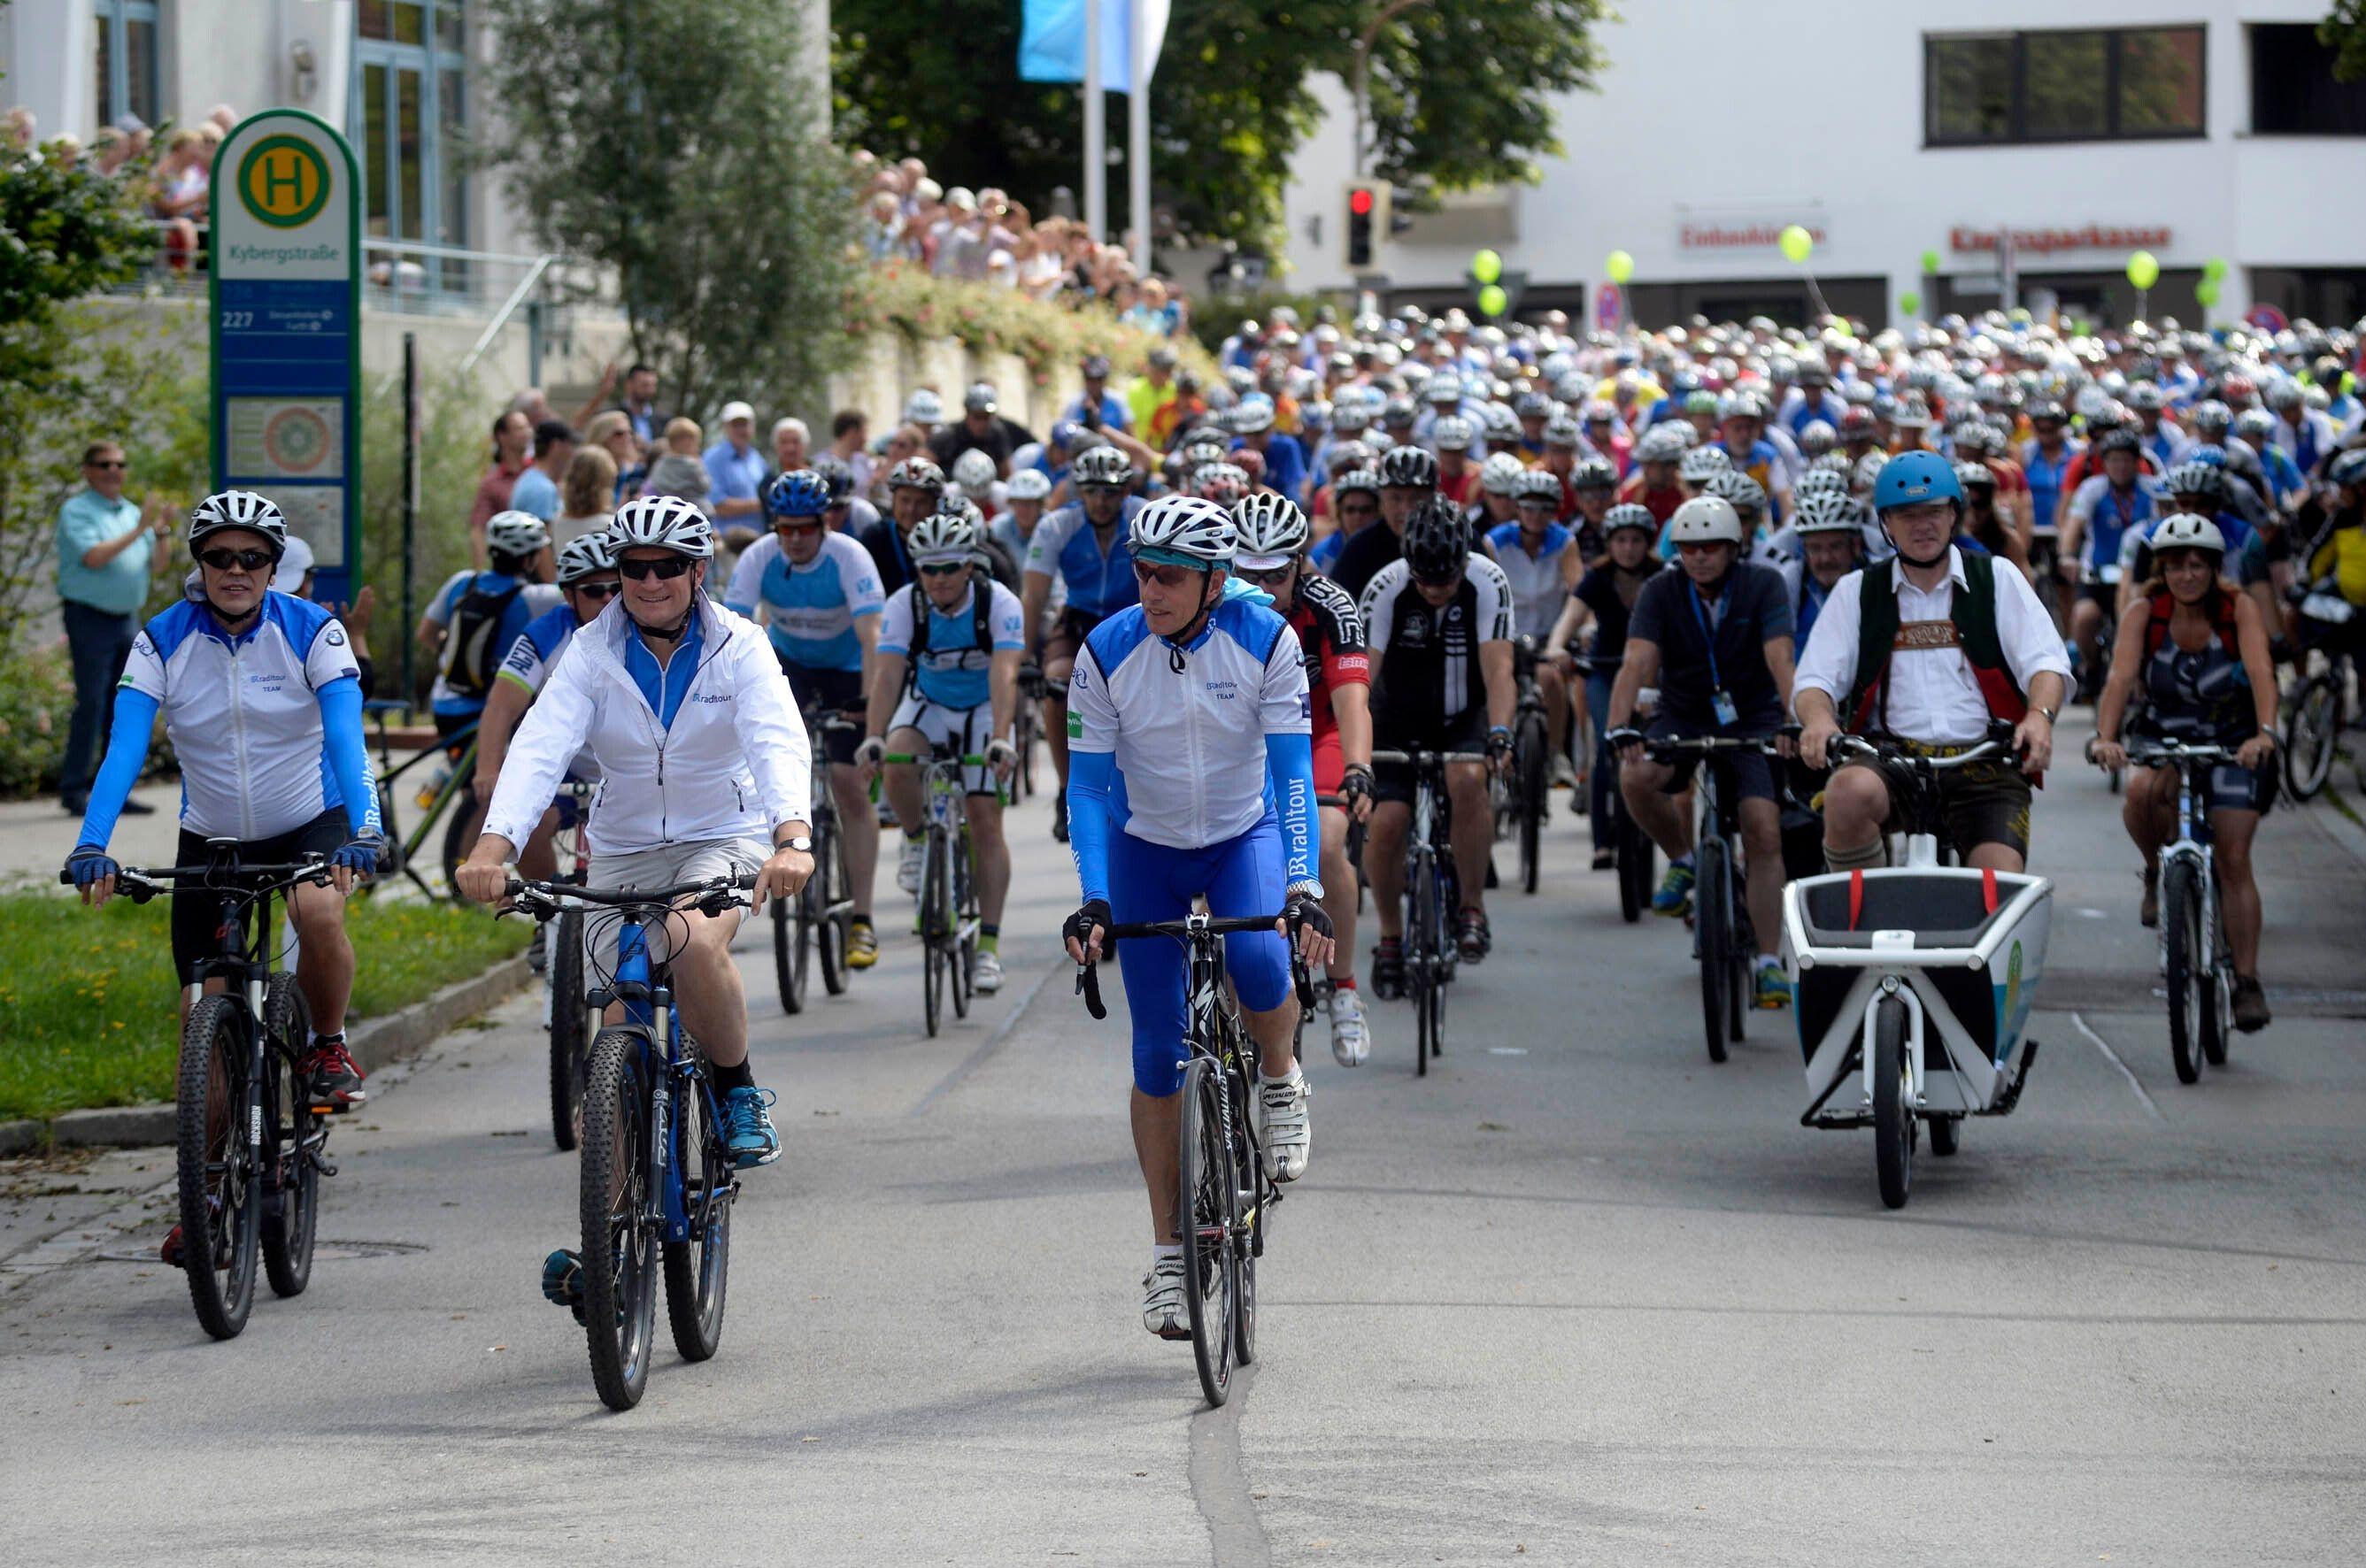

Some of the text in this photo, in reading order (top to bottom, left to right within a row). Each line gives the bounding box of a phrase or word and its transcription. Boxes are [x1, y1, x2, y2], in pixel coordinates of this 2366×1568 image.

[266, 156, 302, 207] H
[1950, 223, 2172, 255] Kressparkasse
[229, 243, 339, 265] Kybergstraße
[221, 311, 254, 328] 227
